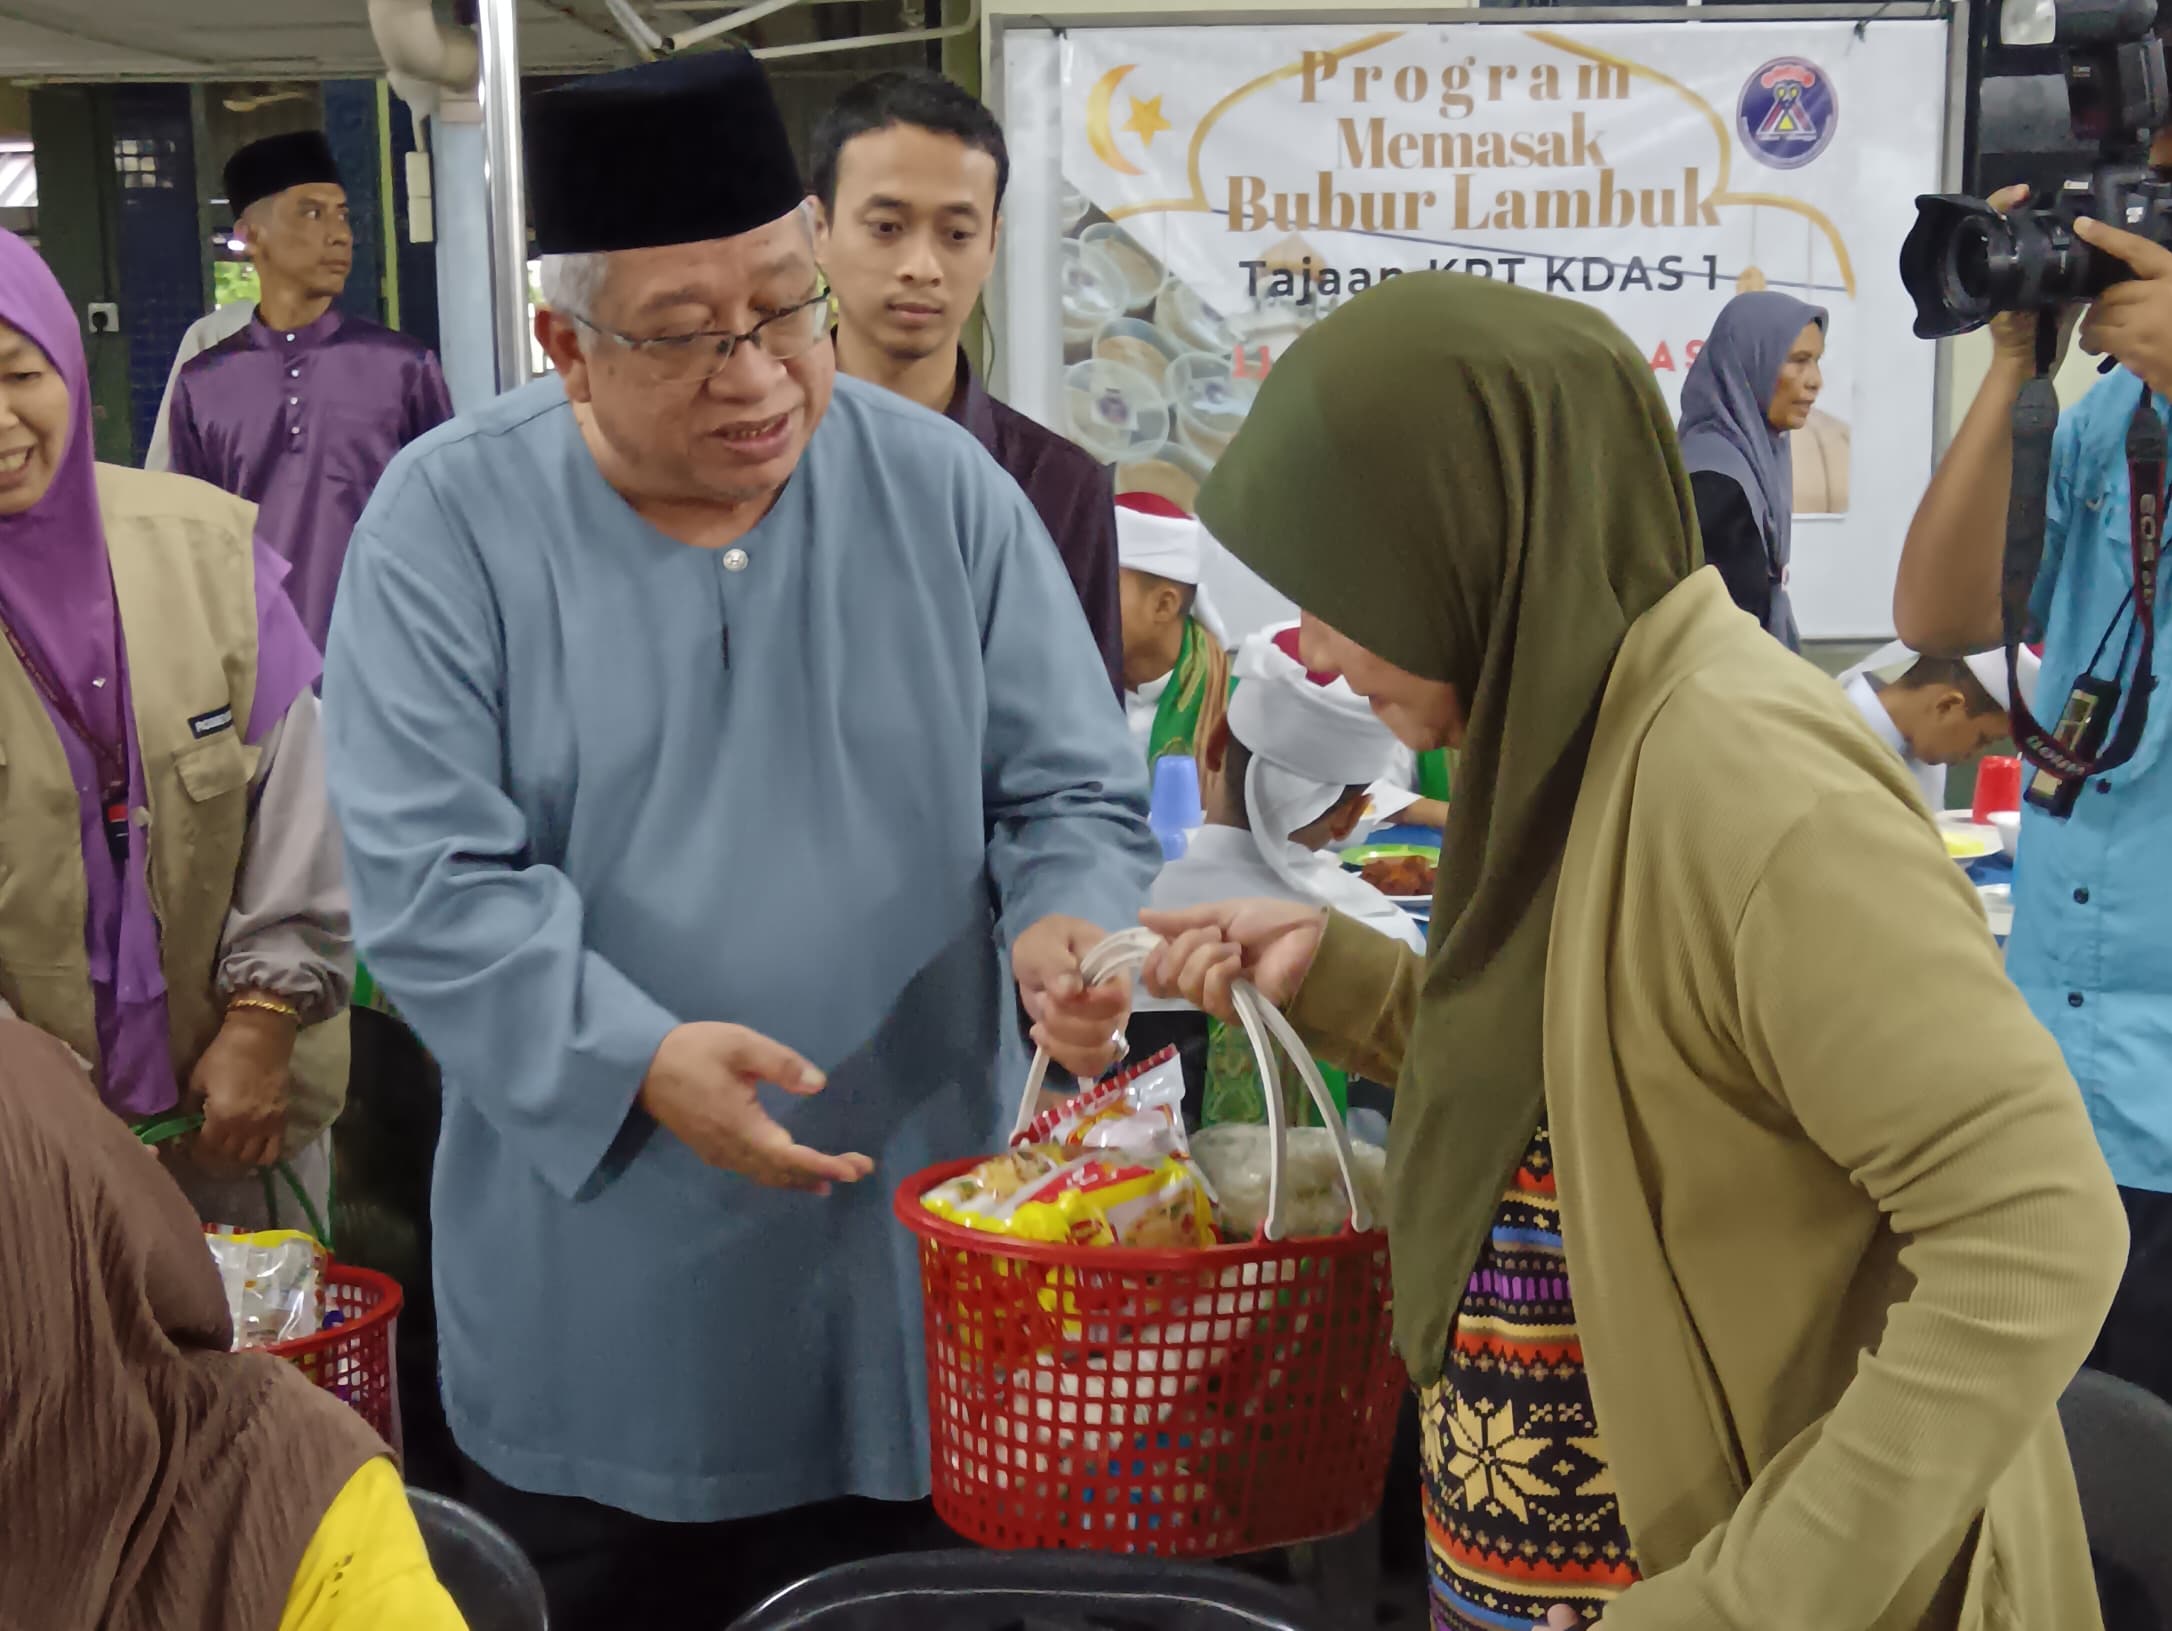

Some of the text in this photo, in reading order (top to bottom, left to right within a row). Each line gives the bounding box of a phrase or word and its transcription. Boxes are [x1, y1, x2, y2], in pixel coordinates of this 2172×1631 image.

[1299, 51, 1630, 119] Program
[1337, 112, 1606, 168] Memasak
[1226, 167, 1720, 232] Bubur Lambuk
[1546, 256, 1683, 292] KDAS
[1703, 255, 1717, 290] 1
